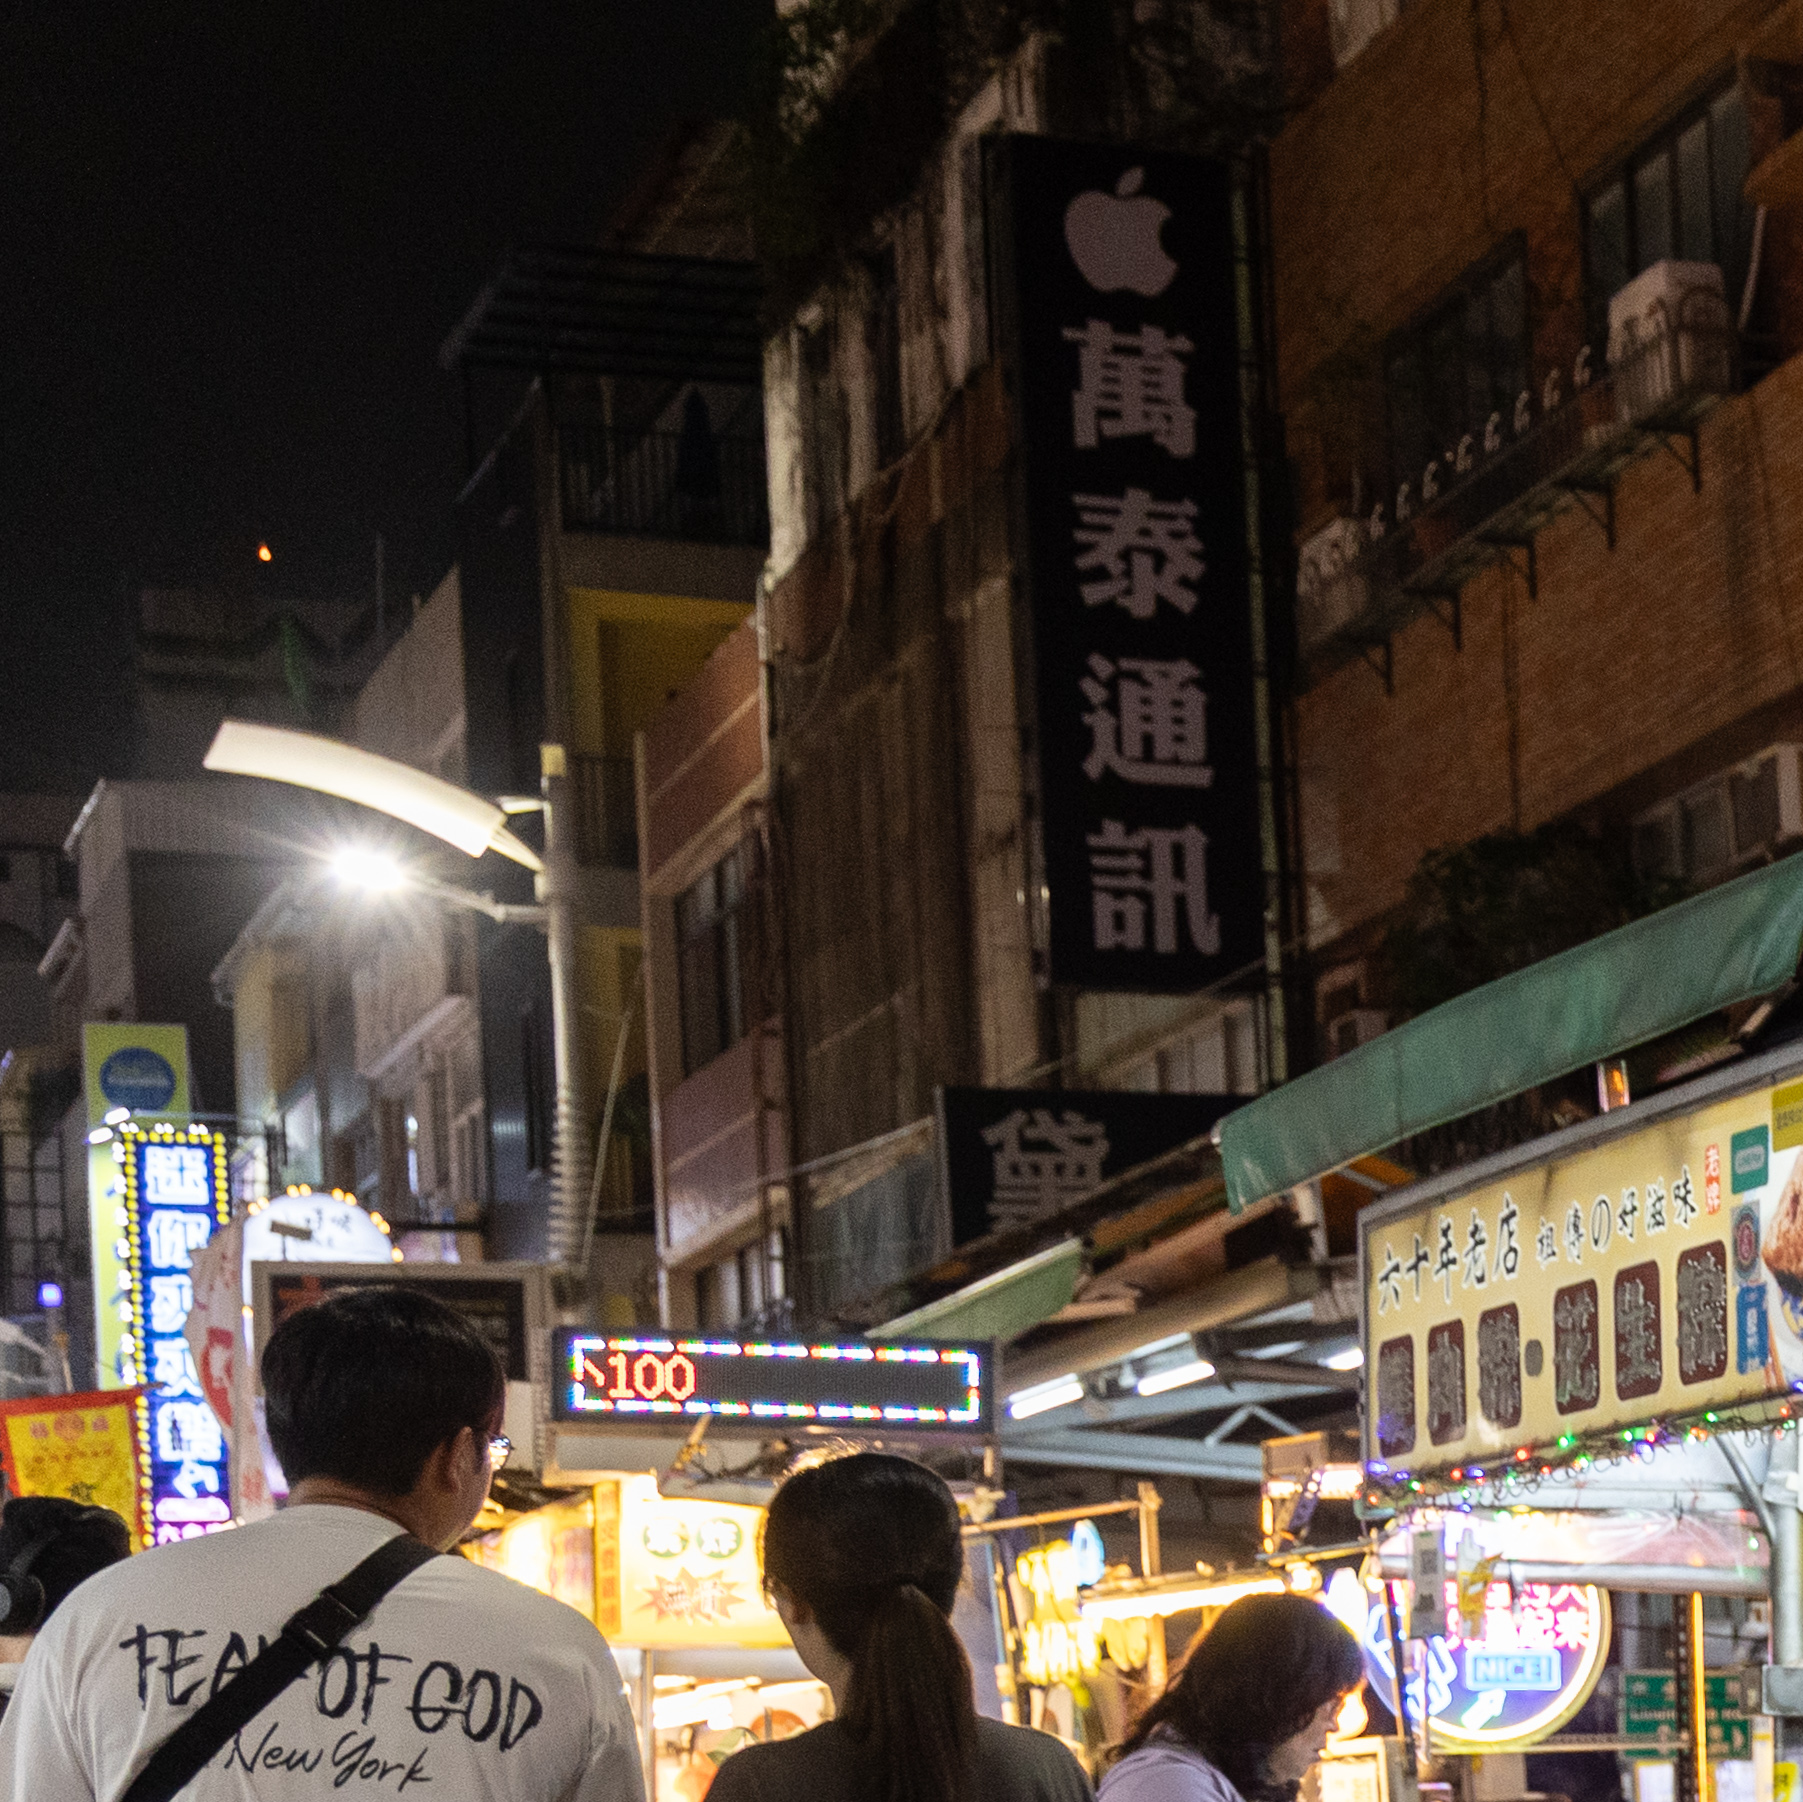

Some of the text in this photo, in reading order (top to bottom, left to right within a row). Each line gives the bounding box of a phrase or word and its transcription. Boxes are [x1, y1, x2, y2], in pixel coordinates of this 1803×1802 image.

[1062, 318, 1222, 956] 萬泰通訊
[1377, 1190, 1522, 1316] 六十年老店
[119, 1623, 544, 1754] FEA OF GOD
[225, 1721, 433, 1793] New York
